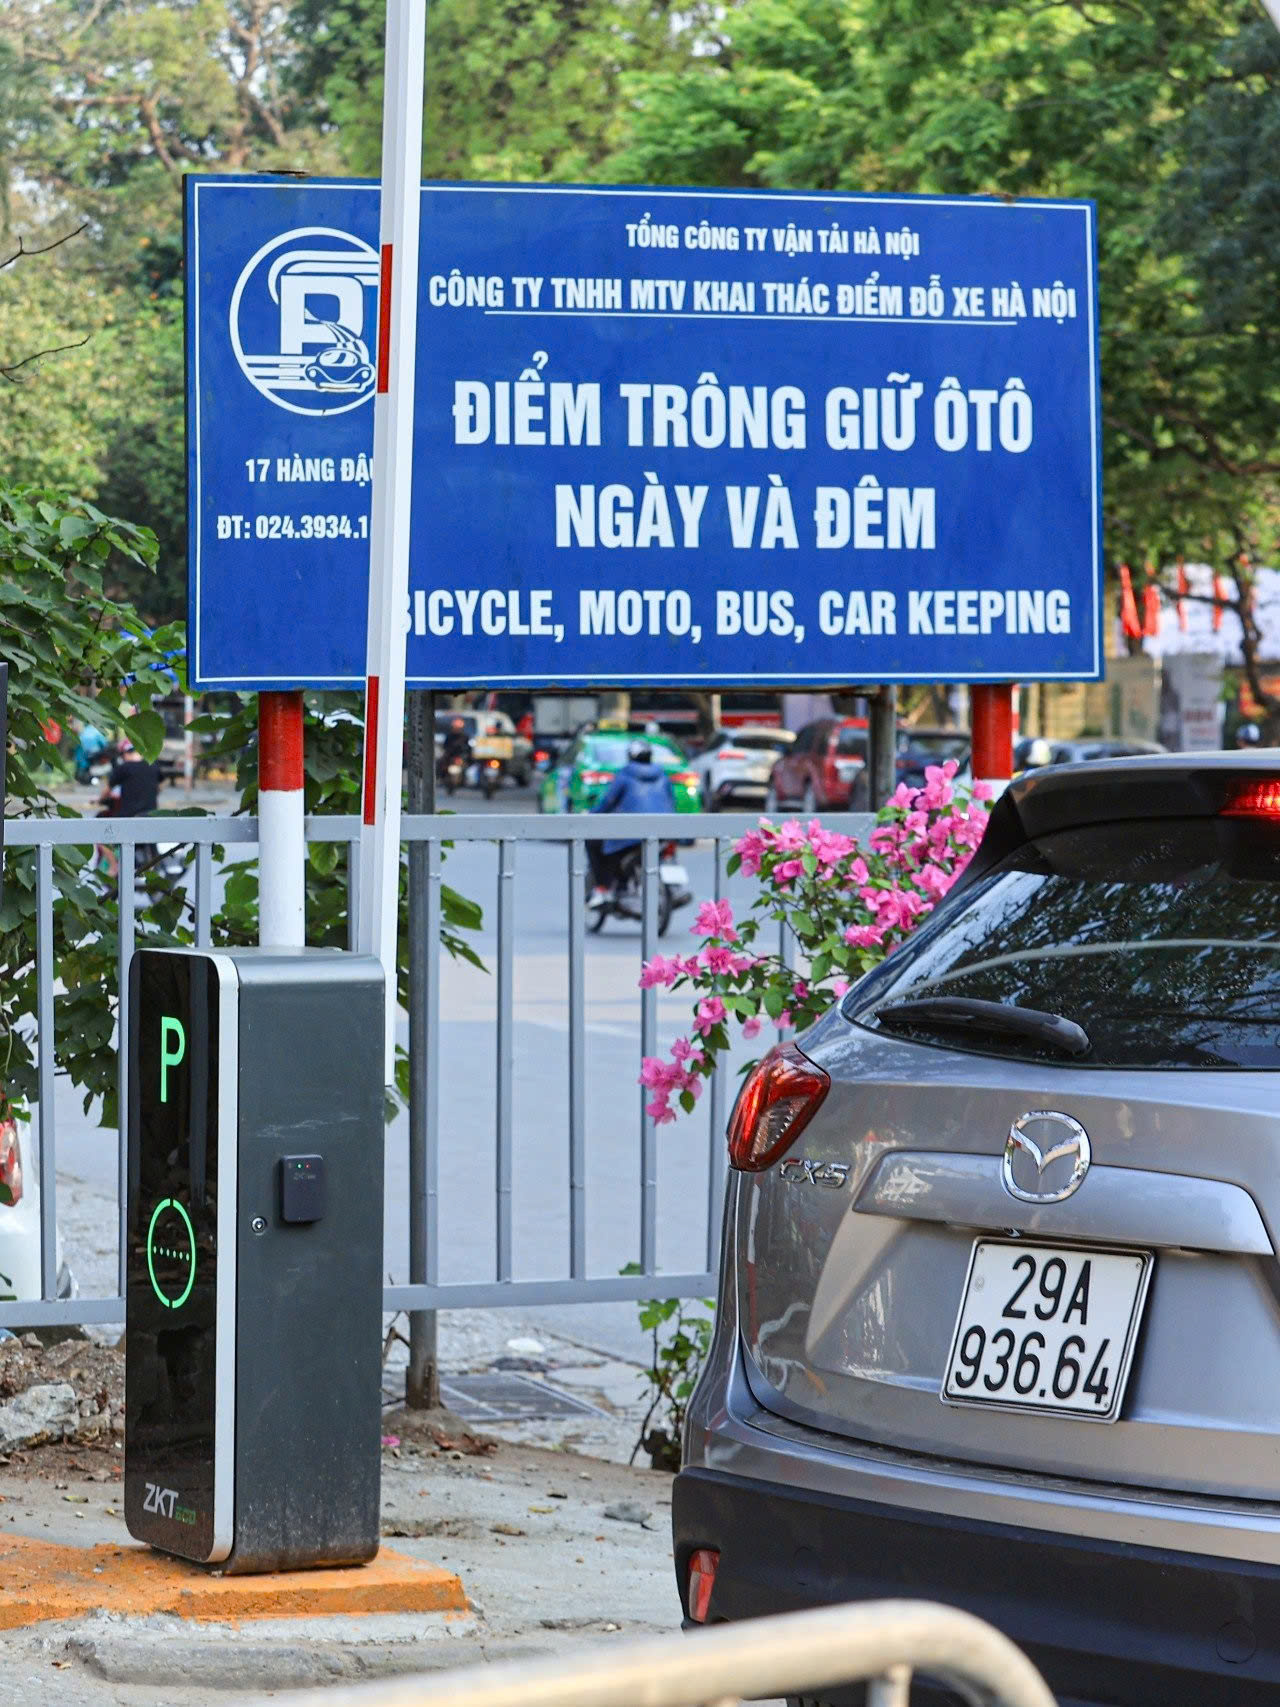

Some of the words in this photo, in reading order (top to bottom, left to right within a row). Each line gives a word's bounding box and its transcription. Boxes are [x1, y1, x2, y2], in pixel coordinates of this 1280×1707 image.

[625, 212, 679, 248] TỔNG
[684, 220, 739, 250] CÔNG
[744, 228, 768, 251] TY
[772, 223, 813, 257] VẬN
[817, 222, 848, 253] TẢI
[853, 226, 881, 254] HÀ
[885, 227, 919, 260] NỘI
[429, 268, 504, 307] CÔNG
[511, 277, 543, 308] TY
[551, 278, 621, 309] TNHH
[630, 279, 686, 311] MTV
[693, 280, 755, 312] KHAI
[762, 276, 829, 314] THÁC
[836, 271, 903, 316] ĐIỂM
[909, 274, 945, 318] ĐỖ
[952, 287, 985, 317] XE
[992, 280, 1027, 318] HÀ
[1033, 280, 1077, 325] NỘI
[452, 350, 602, 447] ĐIỂM
[619, 371, 807, 450] TRÔNG
[825, 372, 924, 451] GIỮ
[933, 376, 1034, 453] ÔTÔ
[245, 458, 270, 483] 17
[276, 453, 335, 482] HÀNG
[217, 515, 251, 540] ĐT:
[256, 515, 368, 539] 024.3934.1
[555, 471, 710, 549] NGÀY
[726, 474, 800, 550] VÀ
[813, 475, 937, 550] ĐÊM
[579, 590, 702, 644] MOTO,
[716, 590, 805, 644] BUS,
[819, 590, 897, 636] CAR
[908, 590, 1071, 635] KEEPING
[160, 1016, 186, 1103] P
[780, 1158, 851, 1189] CX-5
[1002, 1254, 1091, 1325] 29A
[955, 1325, 1111, 1404] 936.64
